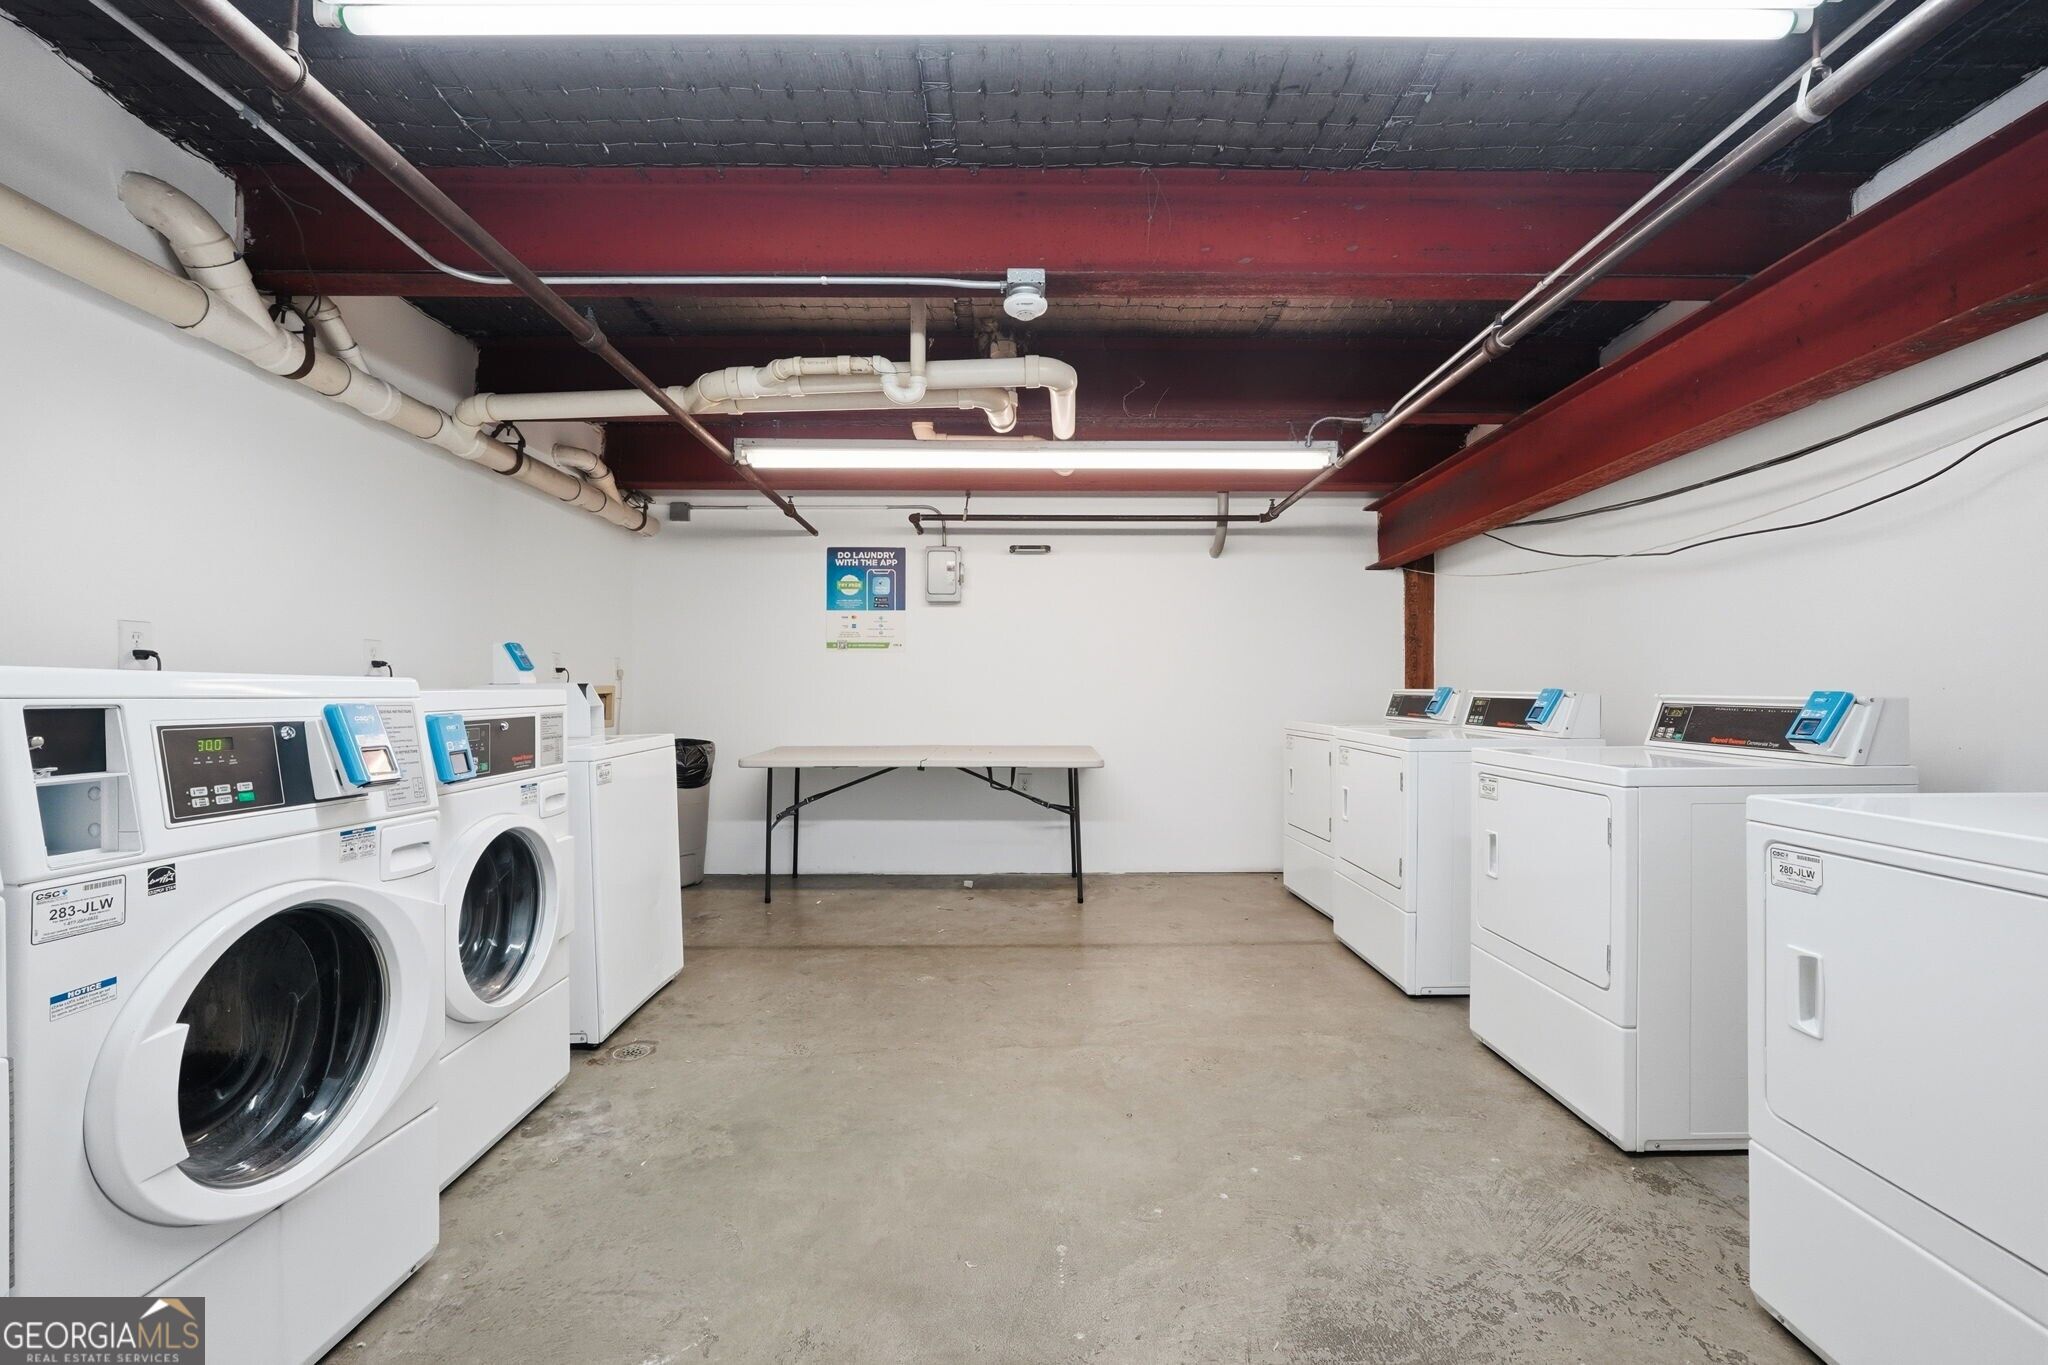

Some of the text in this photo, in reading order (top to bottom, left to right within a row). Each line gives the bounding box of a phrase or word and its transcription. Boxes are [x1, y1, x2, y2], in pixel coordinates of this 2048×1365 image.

[837, 551, 895, 559] DO LAUNDRY
[1779, 865, 1815, 879] 280-JLW
[36, 890, 60, 900] CSC
[49, 897, 114, 921] 283-JLW
[67, 982, 102, 998] NOTICE
